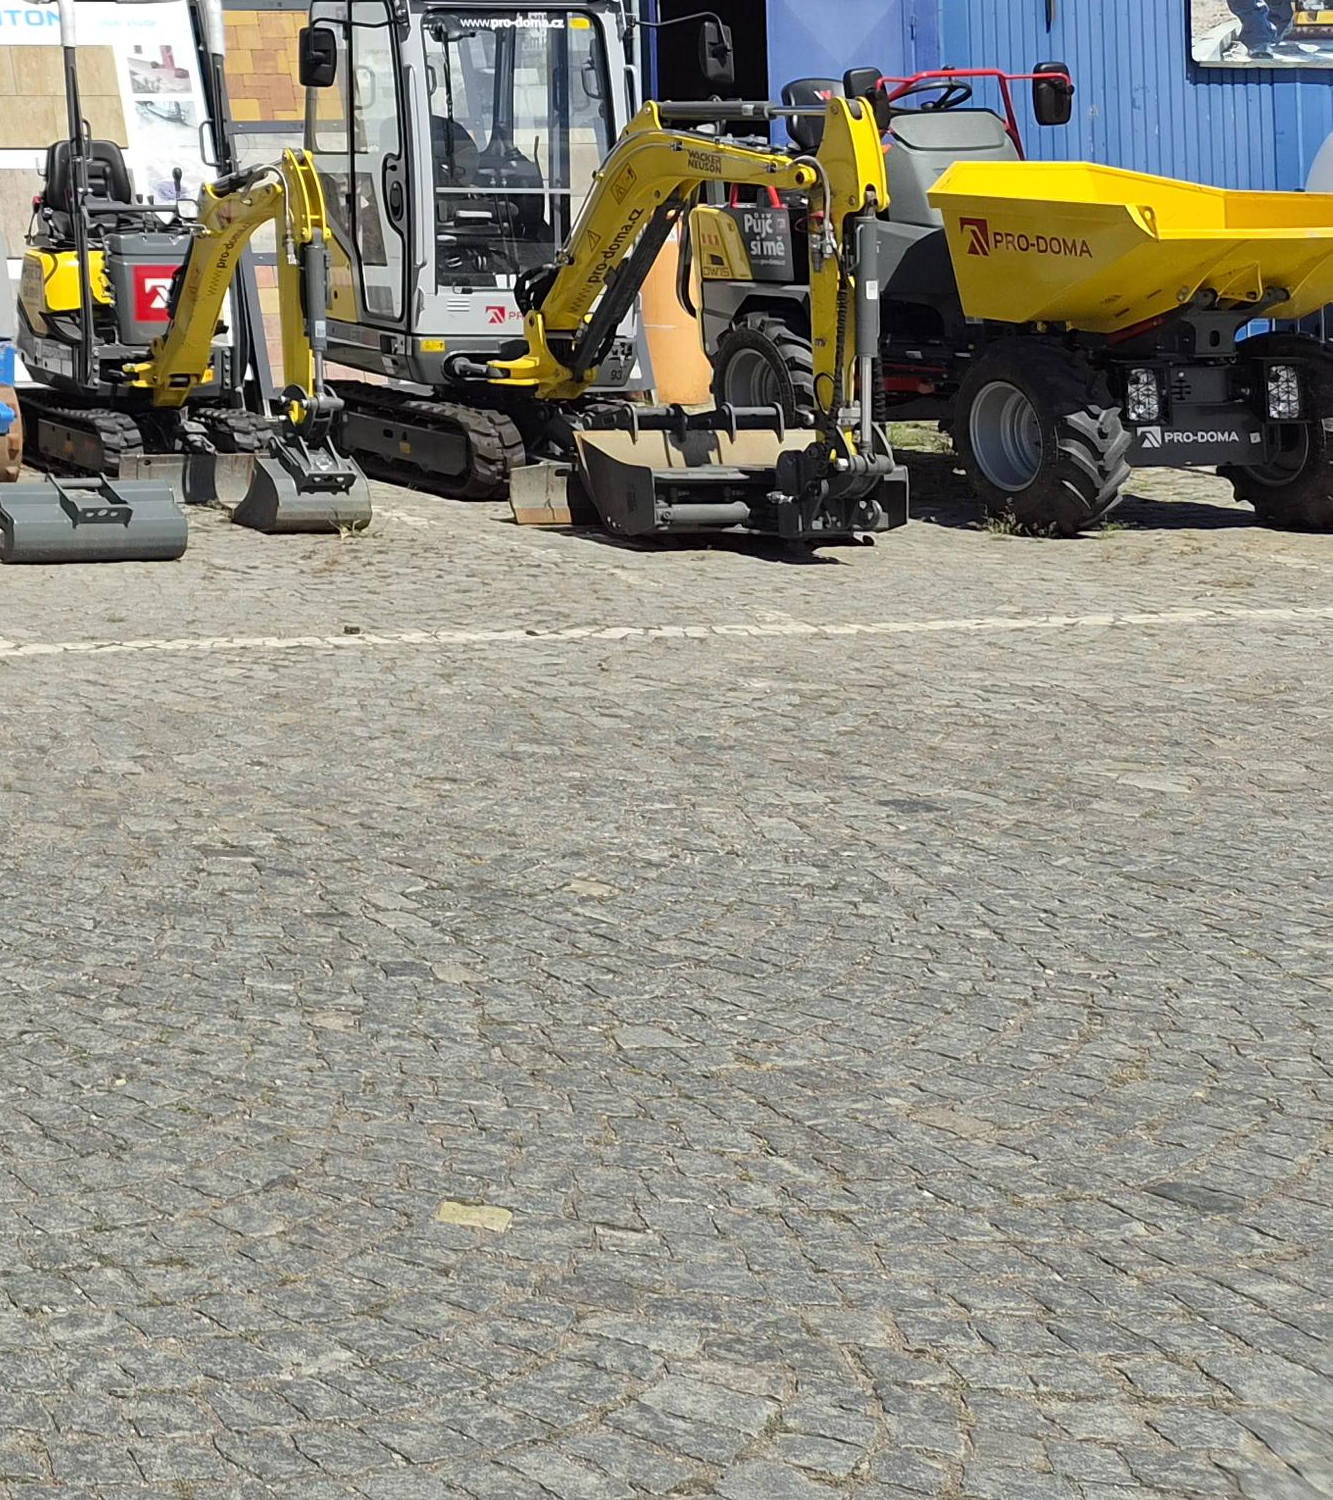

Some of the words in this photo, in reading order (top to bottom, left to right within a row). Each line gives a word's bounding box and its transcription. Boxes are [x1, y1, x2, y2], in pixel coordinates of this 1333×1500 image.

[460, 16, 565, 29] www.pro-doma.cz
[687, 150, 722, 164] WACKER
[687, 159, 722, 174] NEUSON
[744, 213, 774, 238] Půjč
[750, 236, 761, 255] si
[762, 235, 786, 256] mě
[993, 231, 1093, 258] PRO-DOMA
[567, 206, 644, 314] www.pro-doma.cz
[1164, 431, 1240, 443] PRO-DOMA
